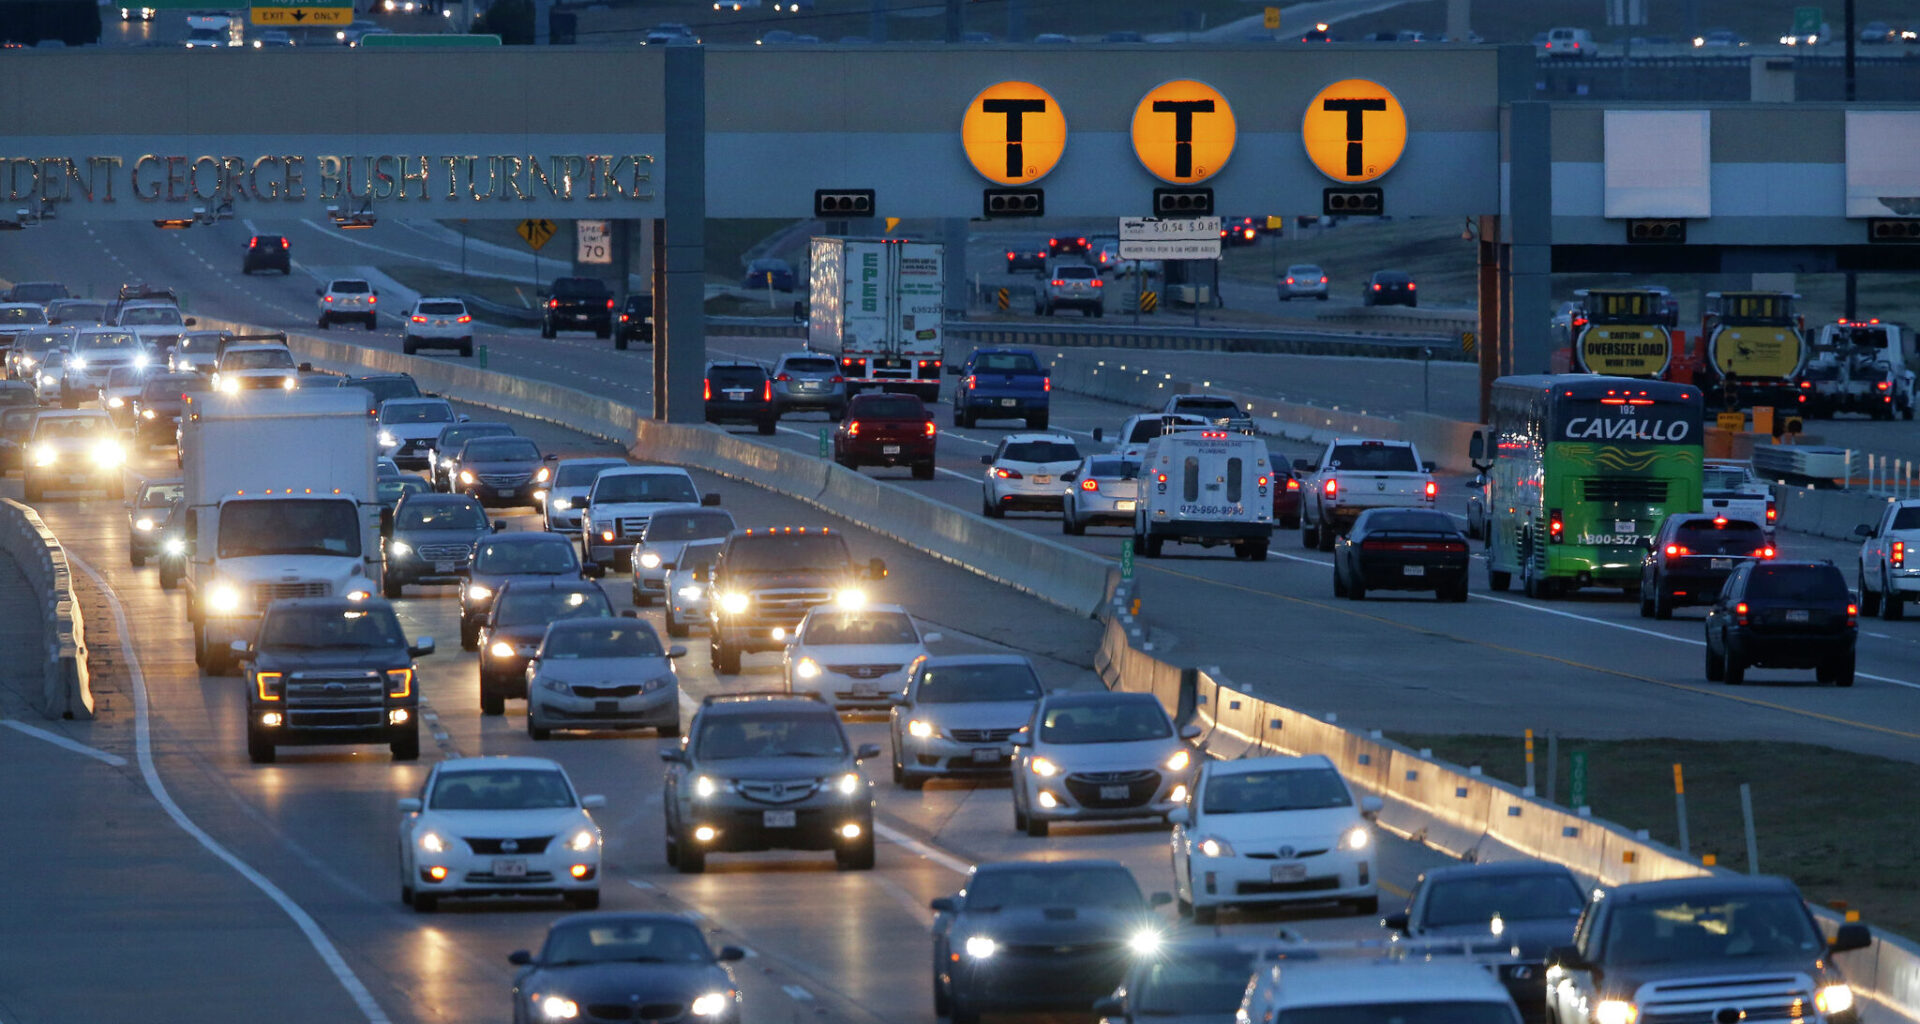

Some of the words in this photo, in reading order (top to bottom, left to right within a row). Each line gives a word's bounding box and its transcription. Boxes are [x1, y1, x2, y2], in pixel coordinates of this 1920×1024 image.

[262, 12, 284, 20] EXIT
[314, 12, 340, 20] ONLY
[983, 99, 1046, 177] T
[1153, 100, 1215, 177] T
[1323, 98, 1386, 176] T
[132, 154, 305, 201] GEORGE
[317, 155, 431, 201] BUSH
[441, 155, 655, 202] TURNPIKE
[584, 245, 604, 257] 70
[1609, 331, 1641, 339] CAUTION
[1588, 343, 1635, 355] OVERSIZE
[1637, 343, 1664, 356] LOAD
[1565, 417, 1689, 441] CAVALLO
